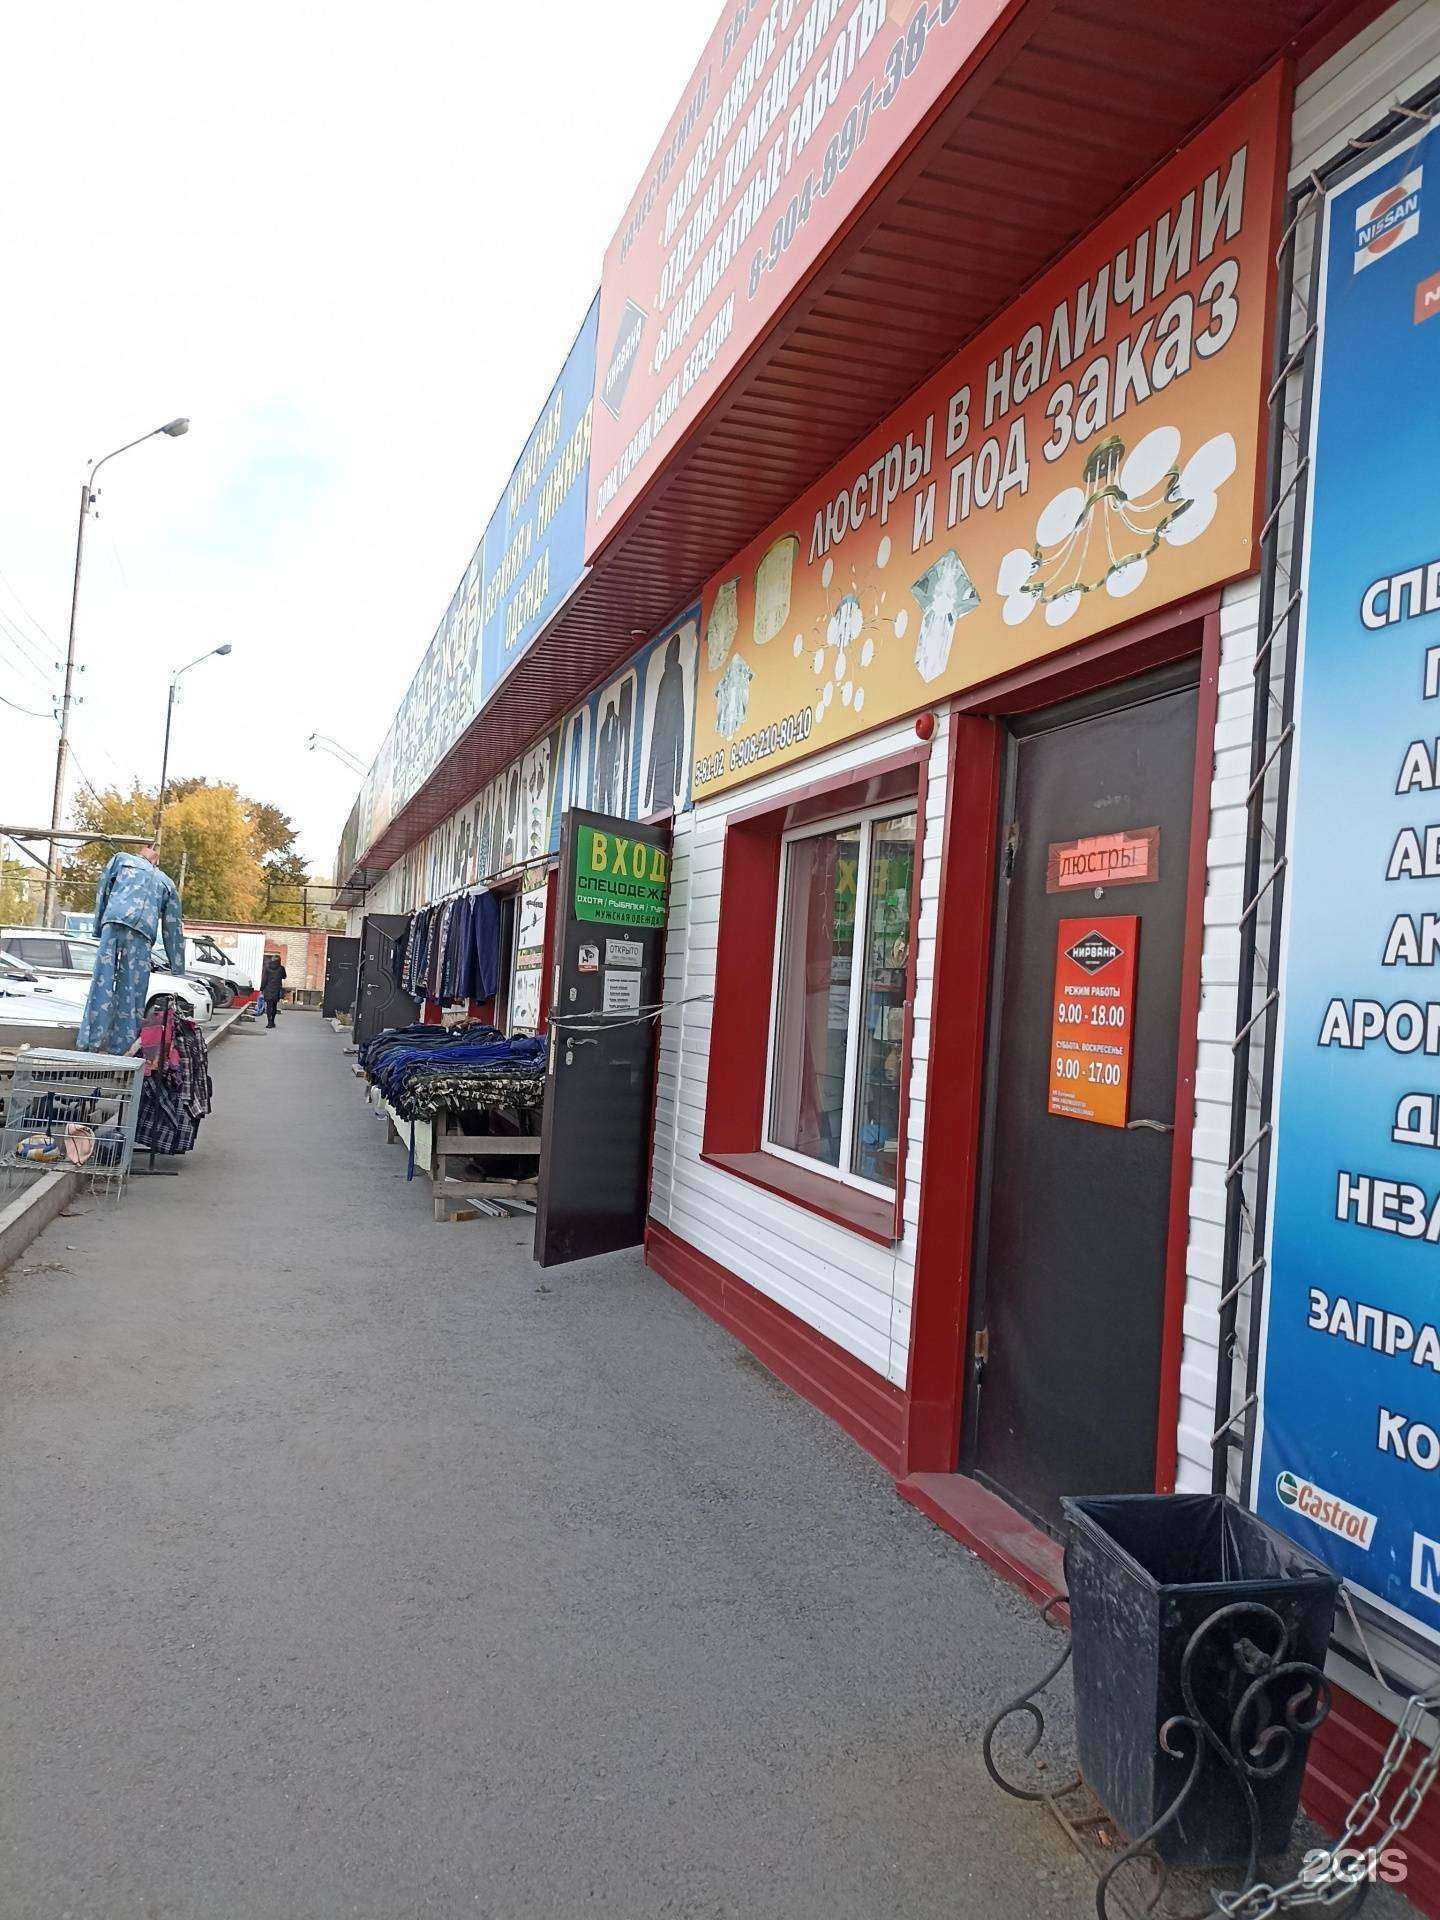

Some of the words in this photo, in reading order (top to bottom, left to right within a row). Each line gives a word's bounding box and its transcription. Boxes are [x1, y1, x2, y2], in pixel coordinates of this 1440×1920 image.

[664, 0, 779, 248] МАЛОЭТАЖНОЕ
[653, 131, 783, 376] ФУНДАМЕНТНЫЕ
[785, 0, 887, 178] РАБОТЫ
[659, 171, 721, 312] ОТДЕЛКА
[1358, 194, 1418, 247] NISSAN
[605, 317, 643, 395] НИРВАНА
[681, 290, 735, 400] БЕСЕДКИ
[537, 399, 593, 542] НИЖНЯЯ
[505, 547, 550, 651] ОДЕЖДА
[730, 705, 812, 772] 8-908-210-80-10
[1395, 735, 1440, 796] А
[592, 832, 666, 883] ВХОД
[610, 944, 639, 956] ОТКРЫТО
[1072, 946, 1116, 958] НИРВАНА
[1058, 1003, 1082, 1024] 9.00
[1090, 1004, 1125, 1027] 18.00
[1064, 985, 1090, 997] РЕЖИМ
[1091, 985, 1120, 998] РАБОТЫ
[1056, 1057, 1080, 1079] 9.00
[1088, 1061, 1121, 1086] 17.00
[1391, 1091, 1440, 1149] Д
[1297, 1485, 1369, 1544] Castrol
